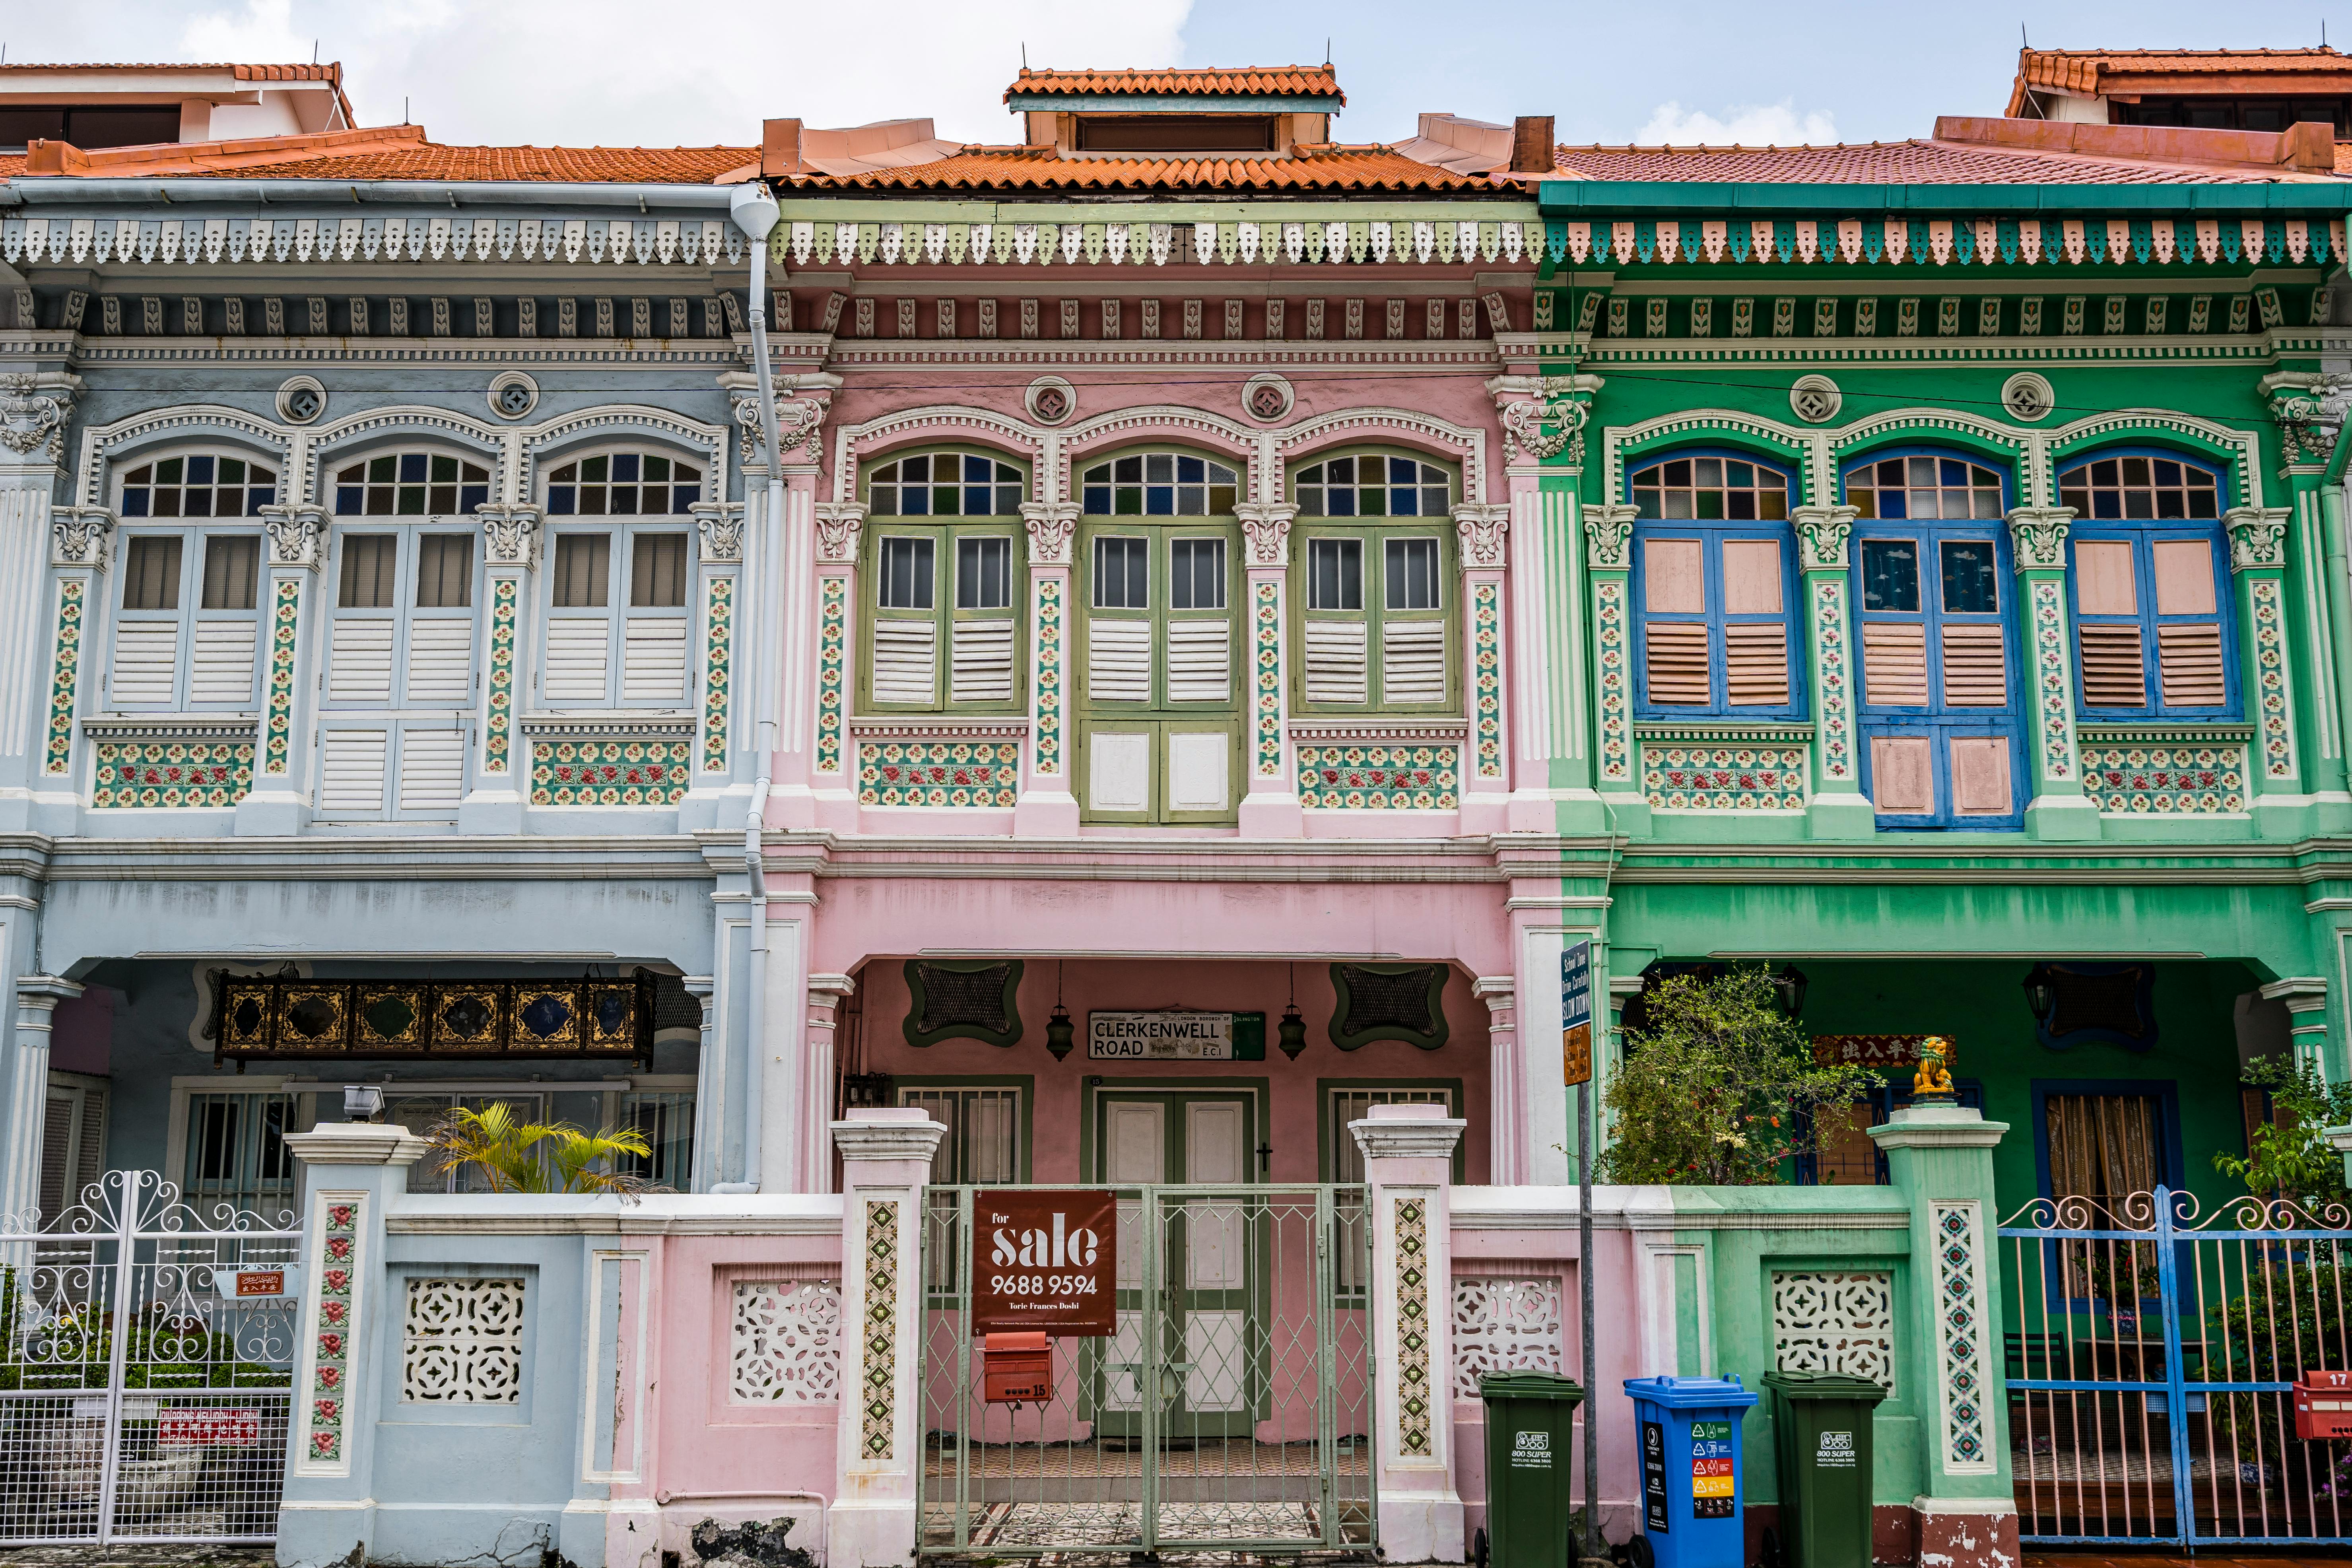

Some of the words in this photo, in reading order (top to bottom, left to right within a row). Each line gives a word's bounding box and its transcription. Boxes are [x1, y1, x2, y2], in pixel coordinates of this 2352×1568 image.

[1564, 954, 1576, 973] School
[1577, 952, 1586, 967] Zone
[1562, 979, 1571, 995] Drive
[1572, 970, 1589, 990] Carefully
[1562, 997, 1575, 1021] SLOW
[1576, 991, 1590, 1016] DOWN
[1095, 1022, 1219, 1038] CLERKENWELL
[1094, 1040, 1143, 1055] ROAD
[992, 1212, 1009, 1224] for
[991, 1212, 1098, 1267] sale
[991, 1275, 1043, 1295] 9688
[1048, 1275, 1098, 1295] 9594
[2329, 1374, 2347, 1385] 17
[1033, 1384, 1046, 1396] 15
